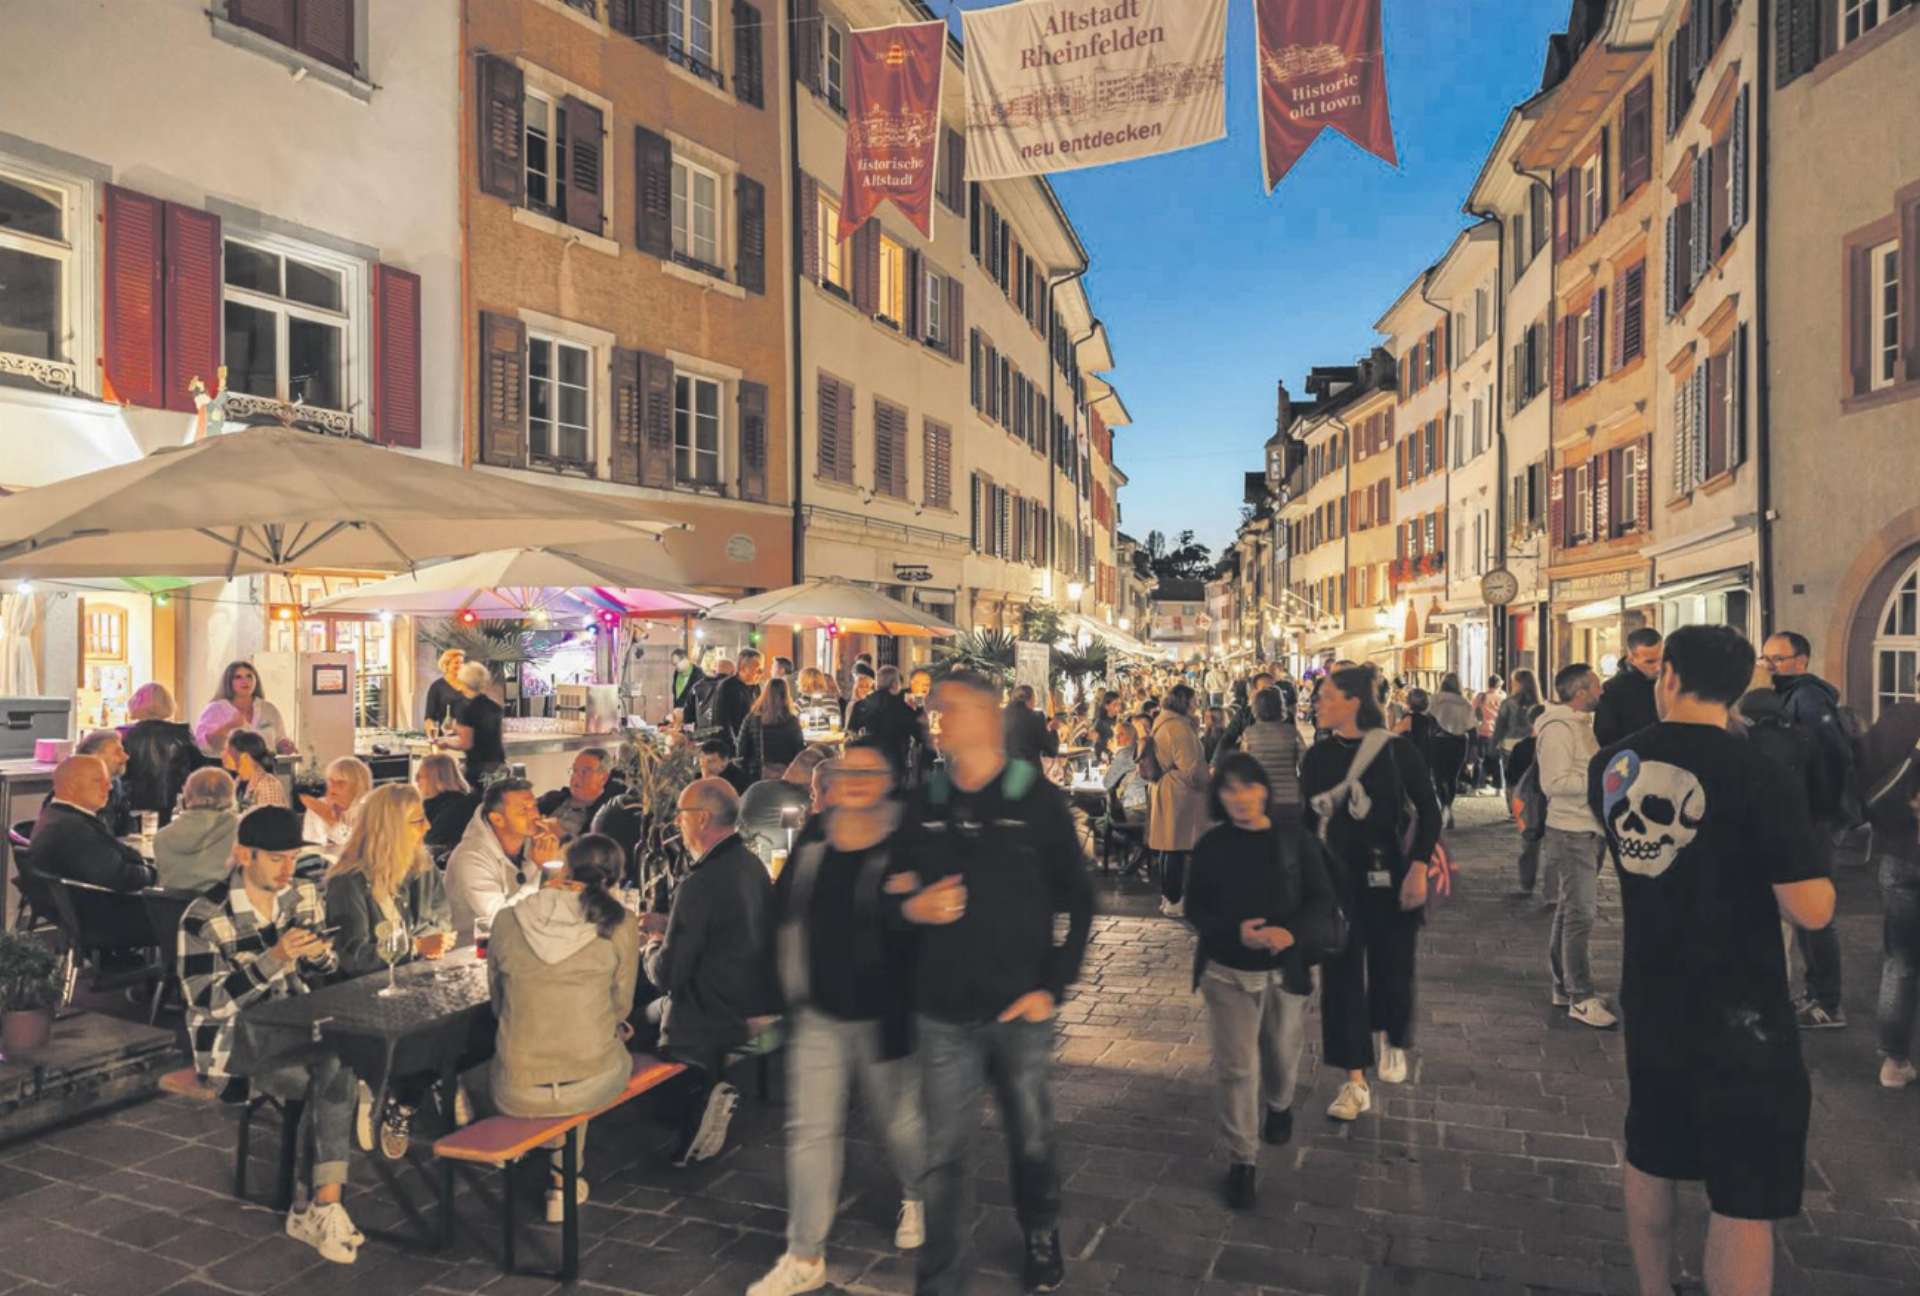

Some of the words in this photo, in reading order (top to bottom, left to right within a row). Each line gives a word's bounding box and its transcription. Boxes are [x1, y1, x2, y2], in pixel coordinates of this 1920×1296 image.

[1044, 0, 1140, 37] Altstadt
[1020, 26, 1165, 70] Rheinfelden
[1291, 73, 1359, 102] Historic
[1289, 102, 1316, 120] old
[1320, 94, 1362, 114] town
[1020, 141, 1055, 159] neu
[1058, 122, 1162, 153] entdecken
[862, 173, 913, 187] Altstadt
